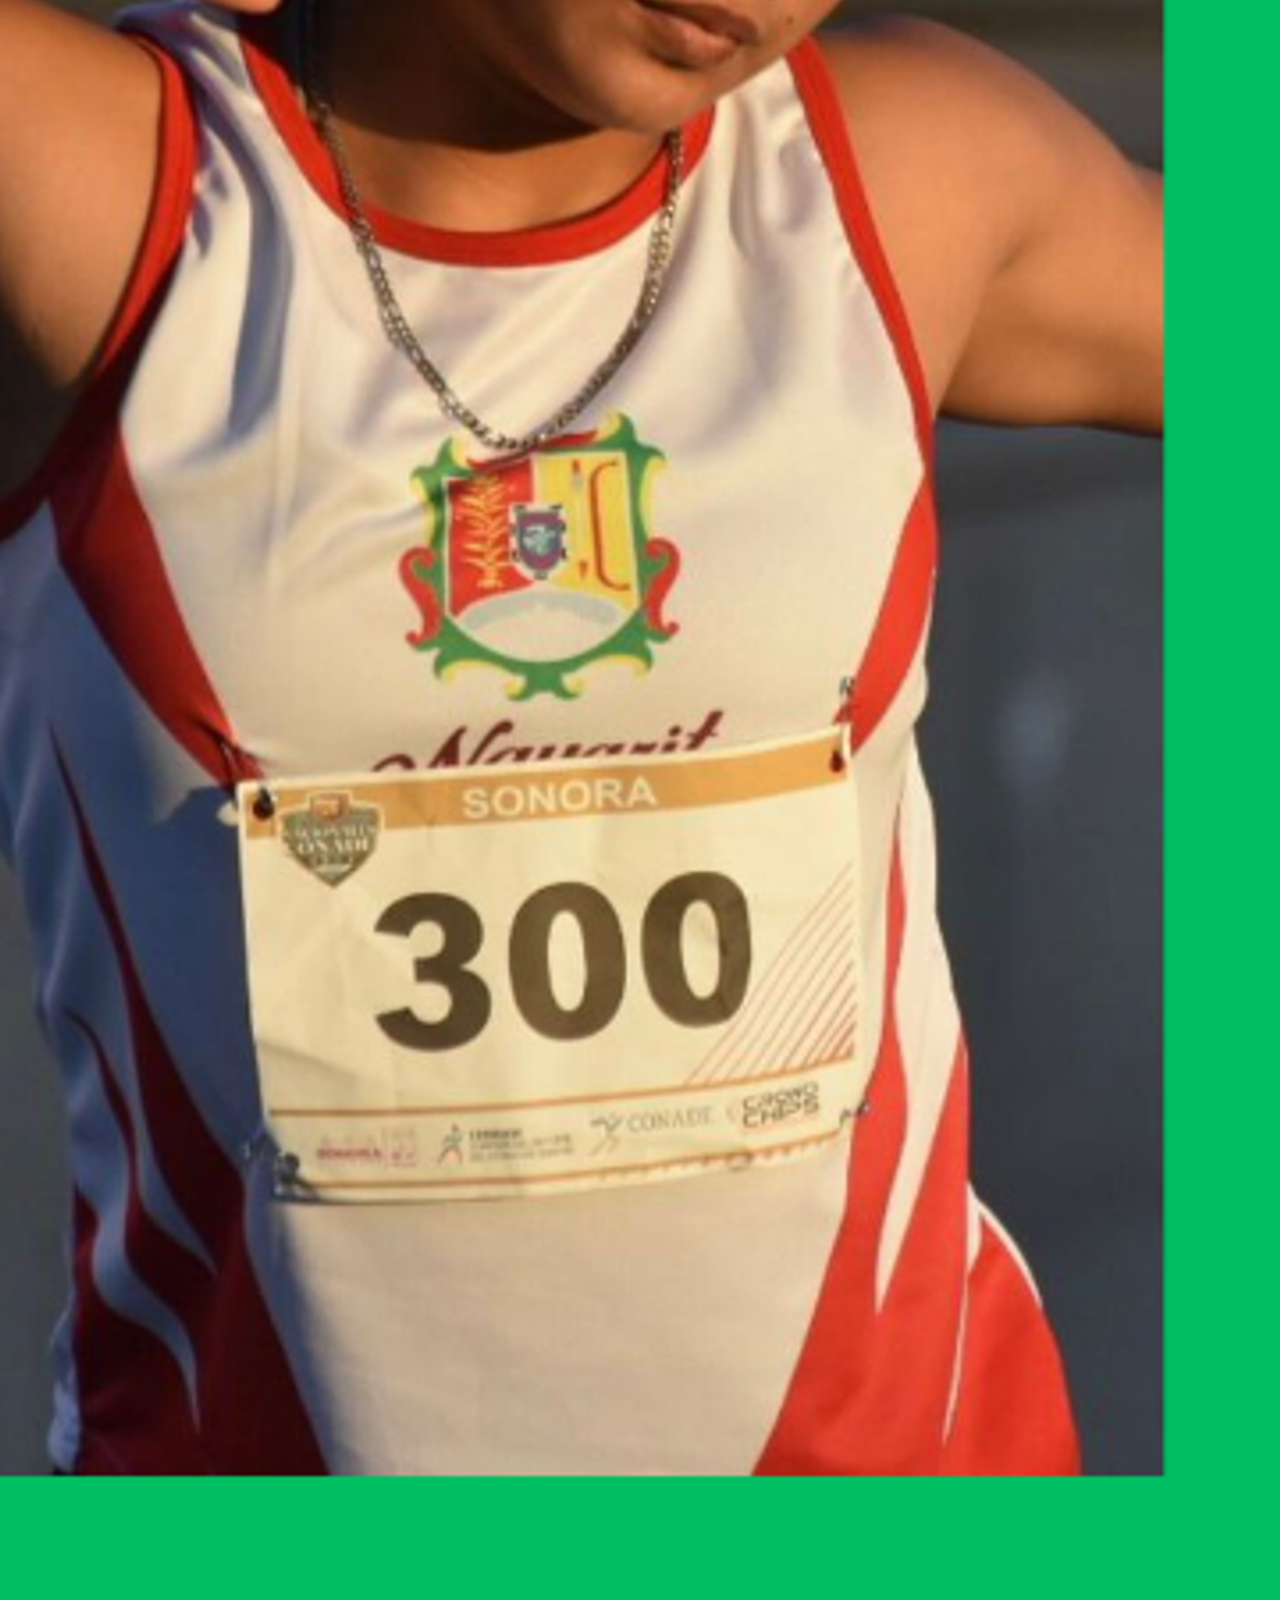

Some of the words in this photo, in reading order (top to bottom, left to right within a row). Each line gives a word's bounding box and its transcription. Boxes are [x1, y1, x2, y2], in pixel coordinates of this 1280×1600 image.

[462, 776, 657, 819] SONORA
[373, 870, 752, 1053] 300
[626, 1106, 713, 1133] CONADE
